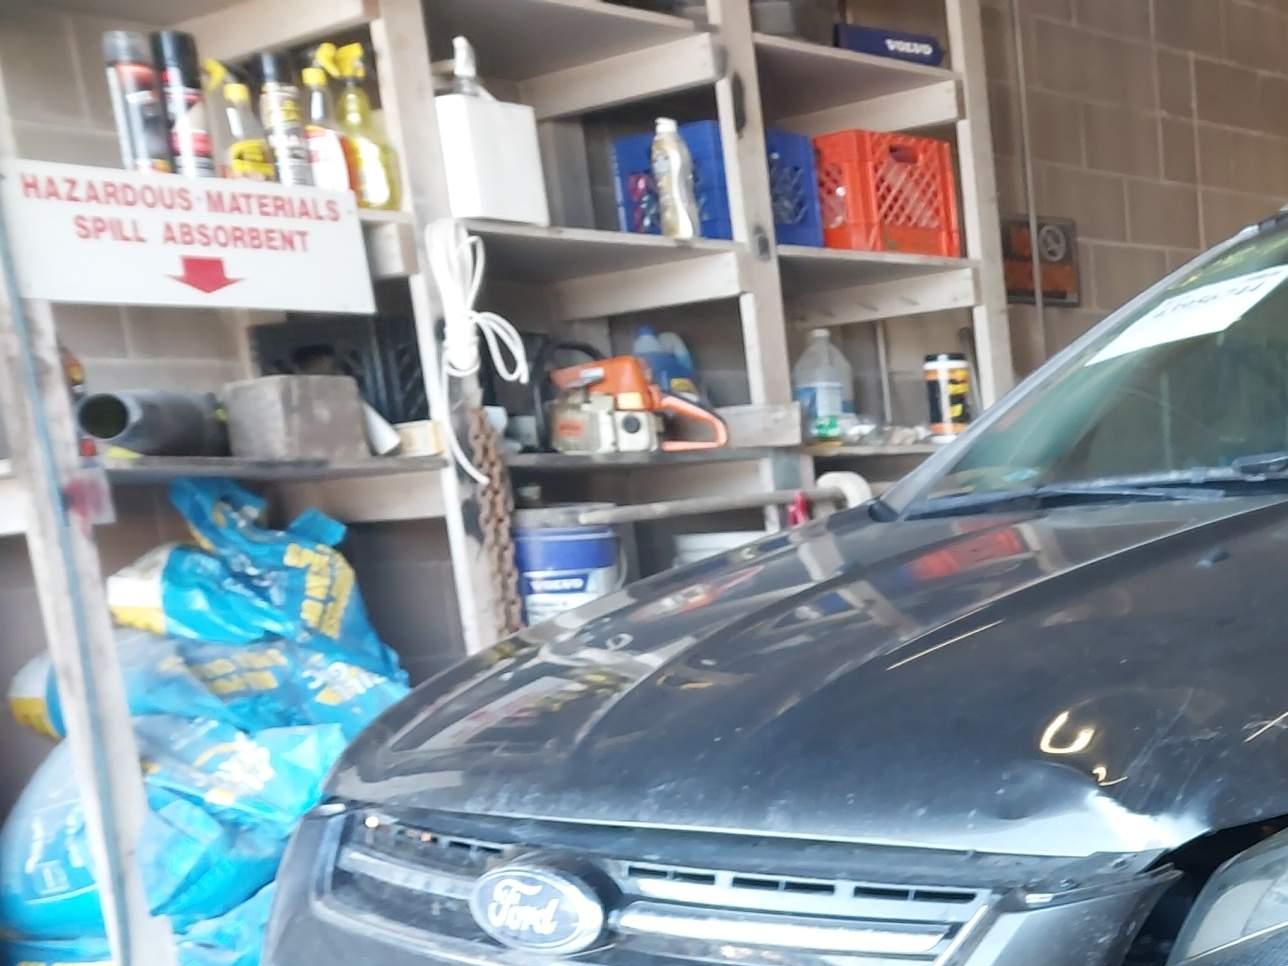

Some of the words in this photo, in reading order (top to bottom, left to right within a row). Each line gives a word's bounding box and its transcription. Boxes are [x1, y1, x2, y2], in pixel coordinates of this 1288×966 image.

[885, 39, 934, 56] VOLVO
[20, 172, 193, 211] HAZARDOUS
[206, 189, 340, 222] MATERIALS
[72, 214, 148, 243] SPILL
[163, 221, 309, 252] ABSORBENT
[487, 878, 561, 936] Ford
